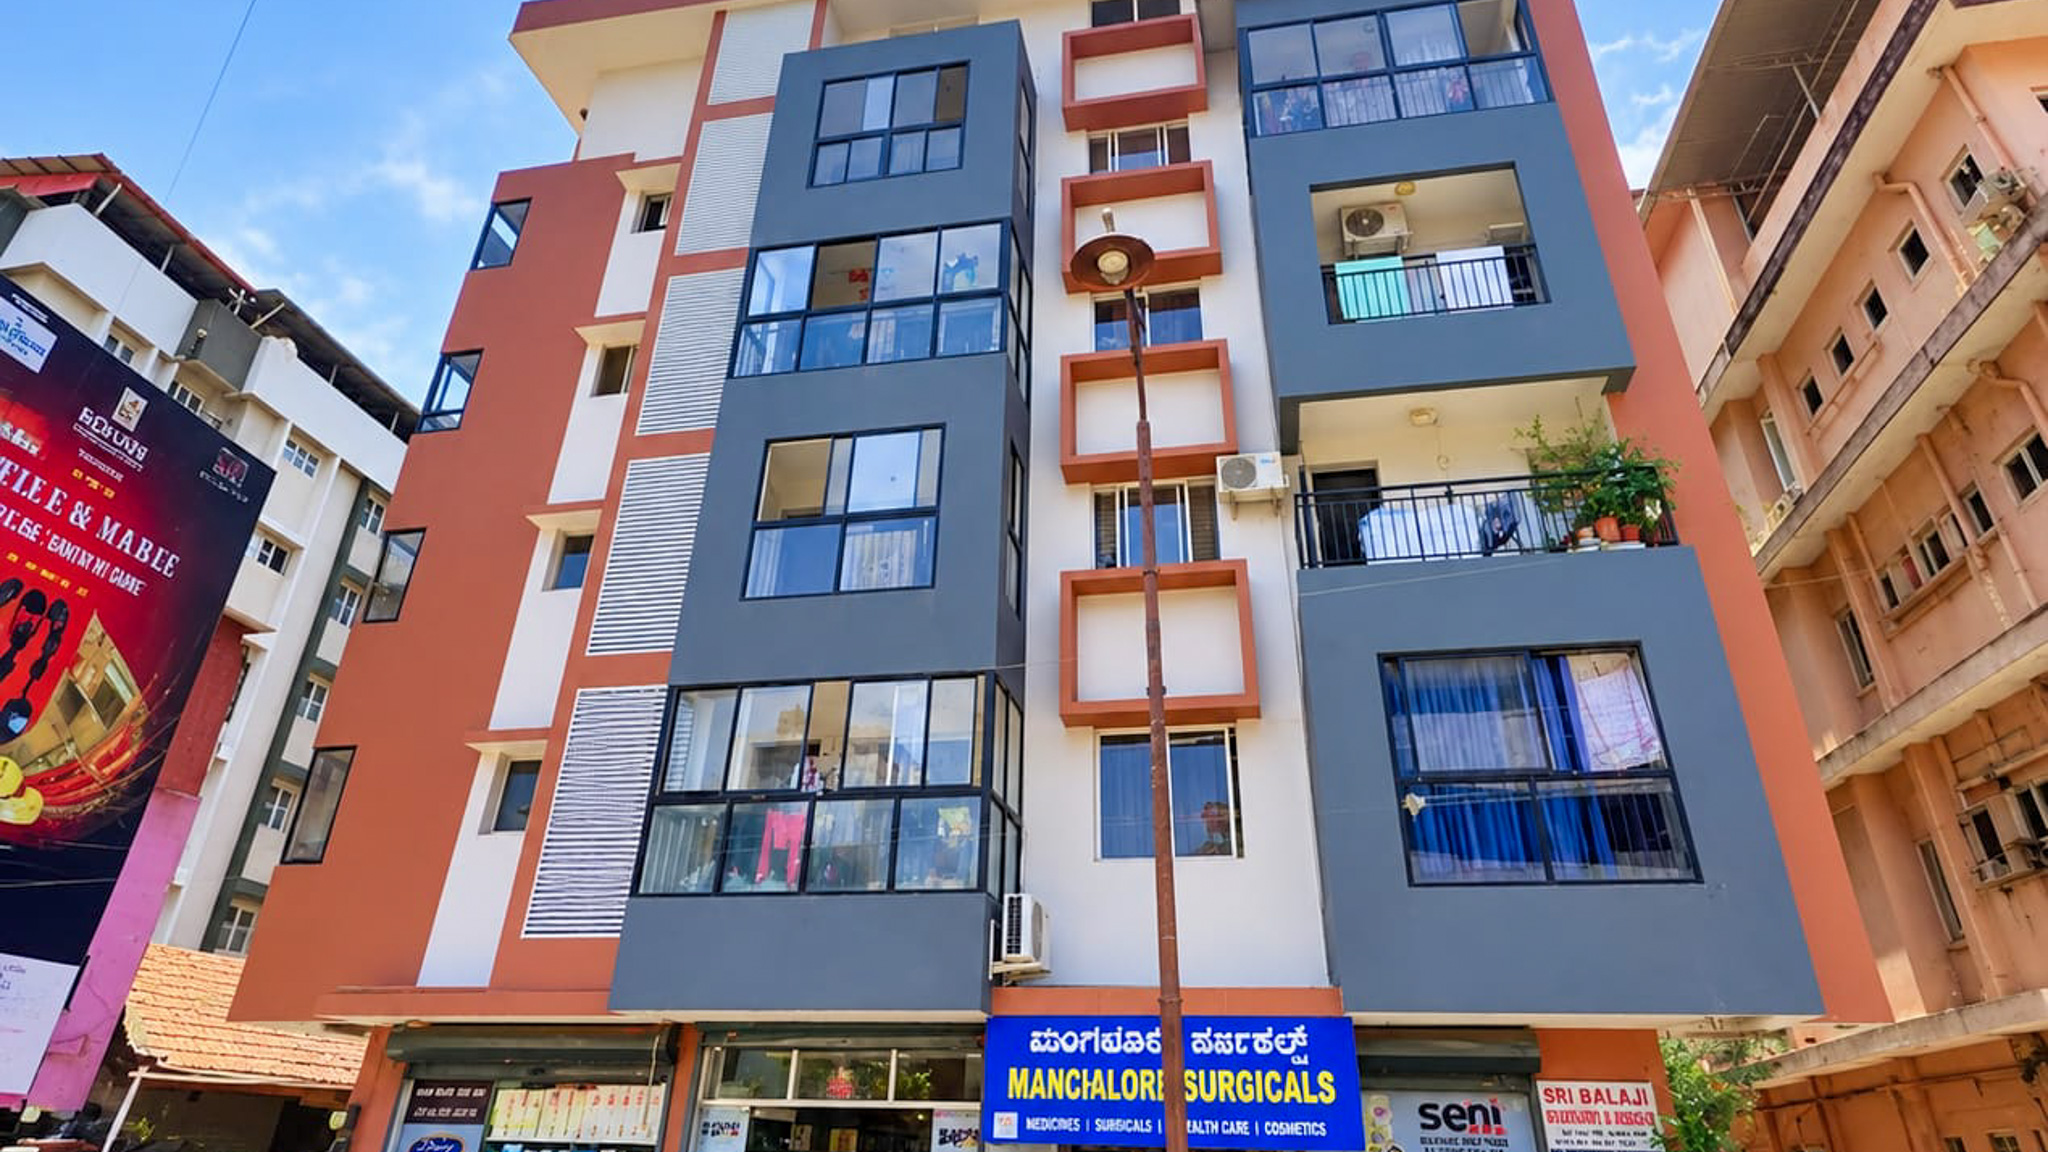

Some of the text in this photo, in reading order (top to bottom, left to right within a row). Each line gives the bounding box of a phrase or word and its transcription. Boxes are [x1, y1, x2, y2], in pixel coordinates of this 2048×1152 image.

[1183, 1069, 1336, 1104] SURGICALS
[1543, 1087, 1650, 1106] SRI BALAJI
[1187, 1119, 1219, 1134] EALTH
[1221, 1121, 1250, 1136] CARE
